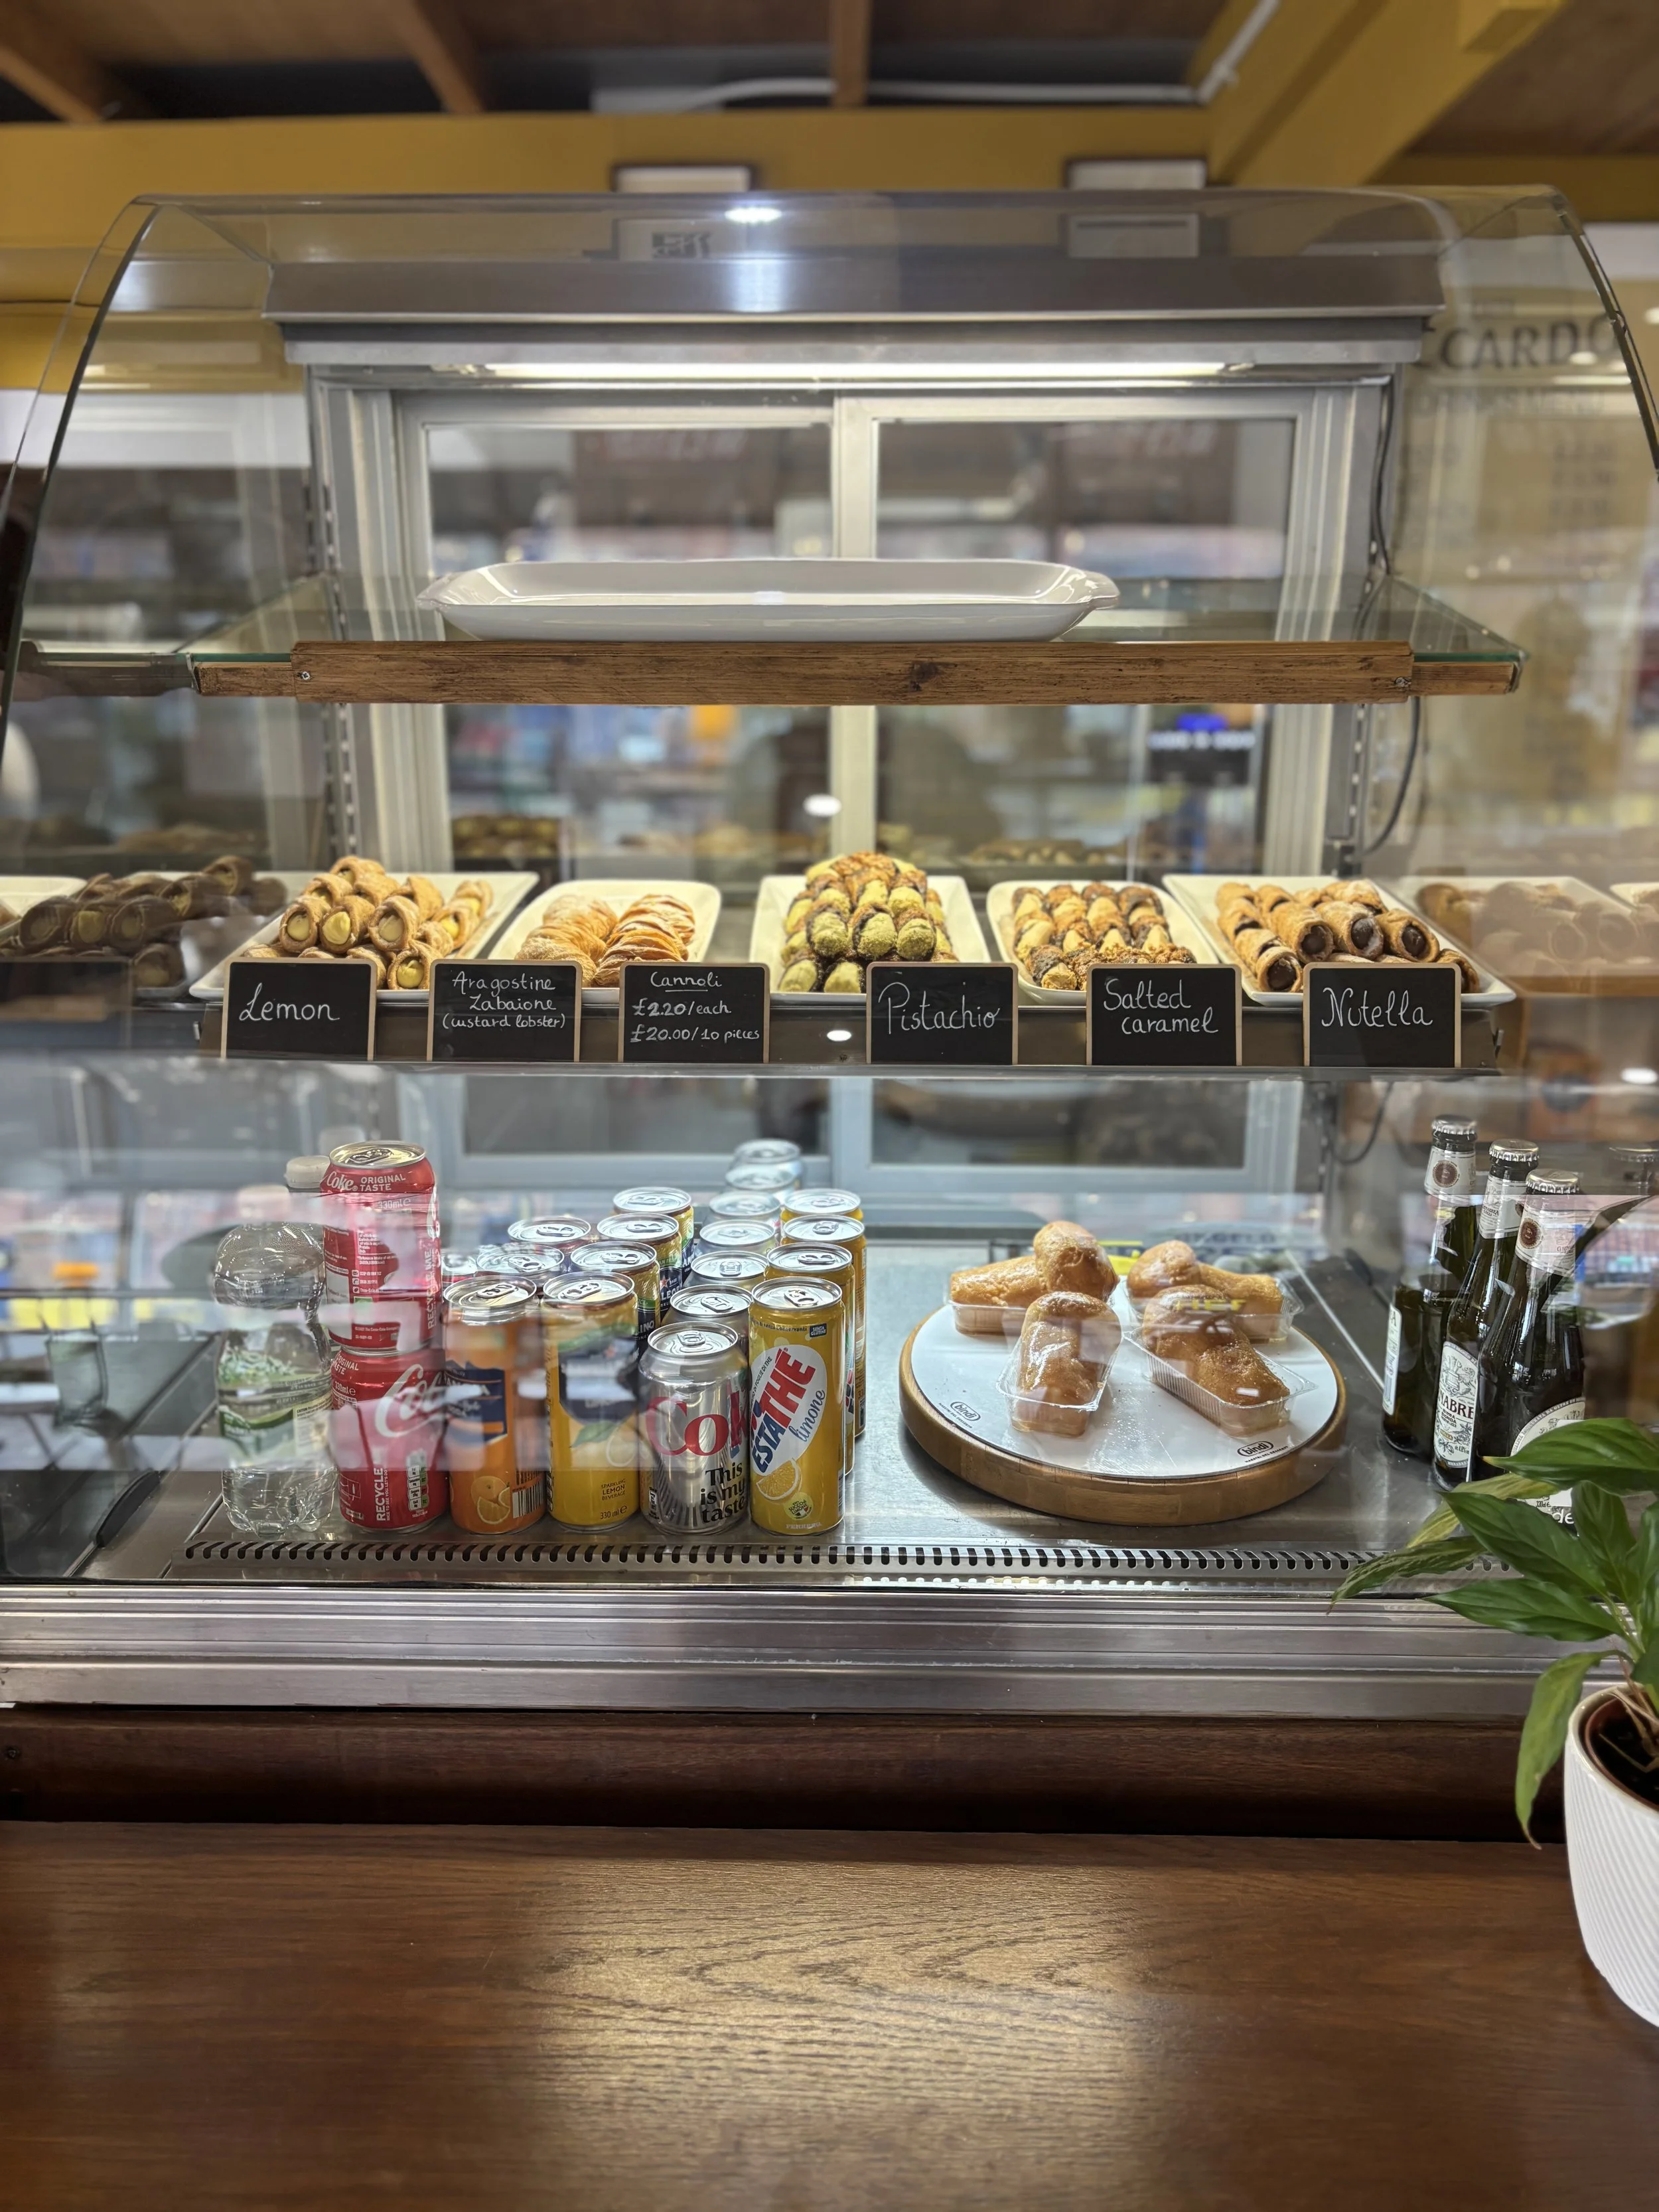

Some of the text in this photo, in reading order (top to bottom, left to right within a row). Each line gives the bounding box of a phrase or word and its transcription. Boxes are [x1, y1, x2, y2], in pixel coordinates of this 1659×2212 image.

[1412, 312, 1620, 369] CARDO
[452, 971, 555, 997] Aragostine
[650, 972, 723, 988] Cannoli
[239, 982, 340, 1021] Lemon
[469, 994, 557, 1011] Zabaione
[1104, 978, 1192, 1011] Salted
[878, 982, 1001, 1035] Pistachio
[1321, 987, 1433, 1027] Nutella
[443, 1013, 565, 1029] (custard lobster)
[724, 1029, 760, 1043] pieces
[326, 1171, 406, 1191] Coke ORIGINAL
[360, 1183, 392, 1192] TASTE
[788, 1389, 826, 1442] limone
[954, 1404, 977, 1419] bindi
[1242, 1442, 1269, 1455] bindi
[705, 1462, 743, 1486] This
[374, 1467, 386, 1521] RECYCLE
[603, 1484, 625, 1495] LEMON
[700, 1478, 745, 1505] is my
[701, 1498, 745, 1523] taste
